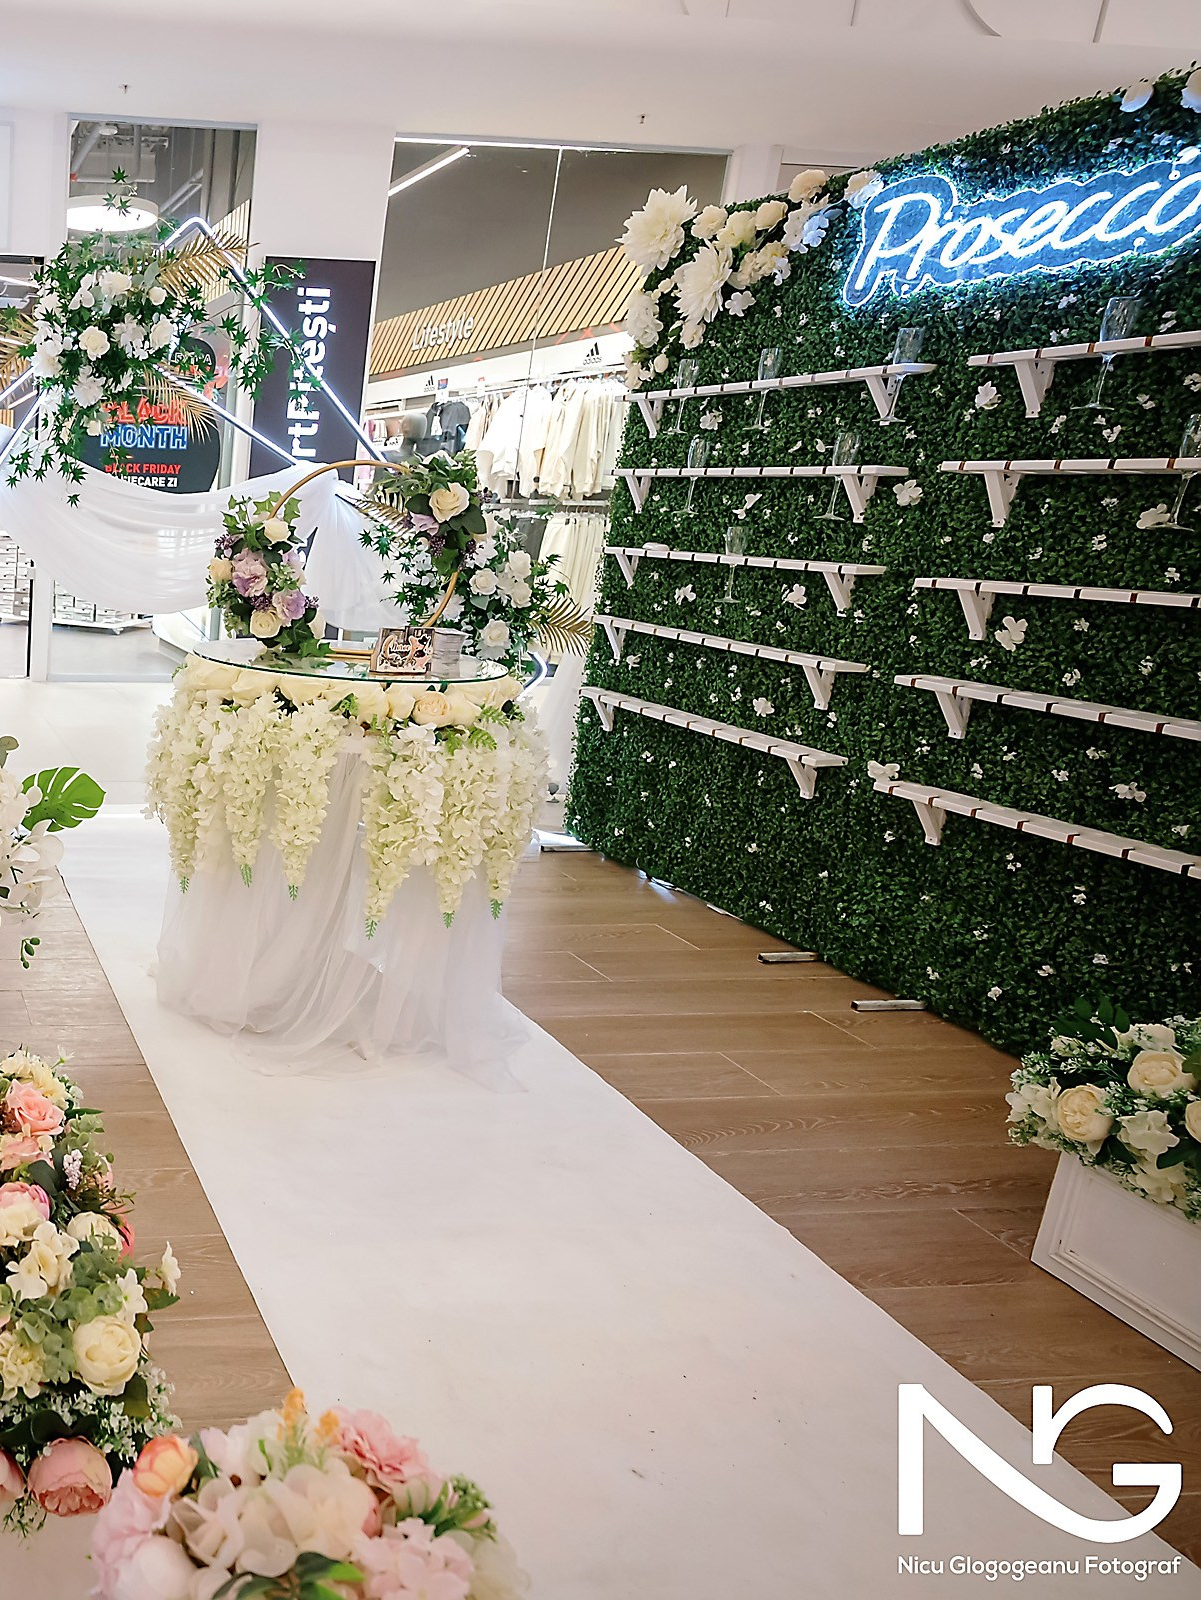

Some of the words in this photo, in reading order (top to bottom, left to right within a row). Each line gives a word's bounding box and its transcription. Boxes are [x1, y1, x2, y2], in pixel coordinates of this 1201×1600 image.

[854, 170, 1201, 290] Prosecco
[412, 311, 474, 351] Lifestyle
[100, 424, 188, 450] MONTH
[143, 464, 181, 475] FRIDAY
